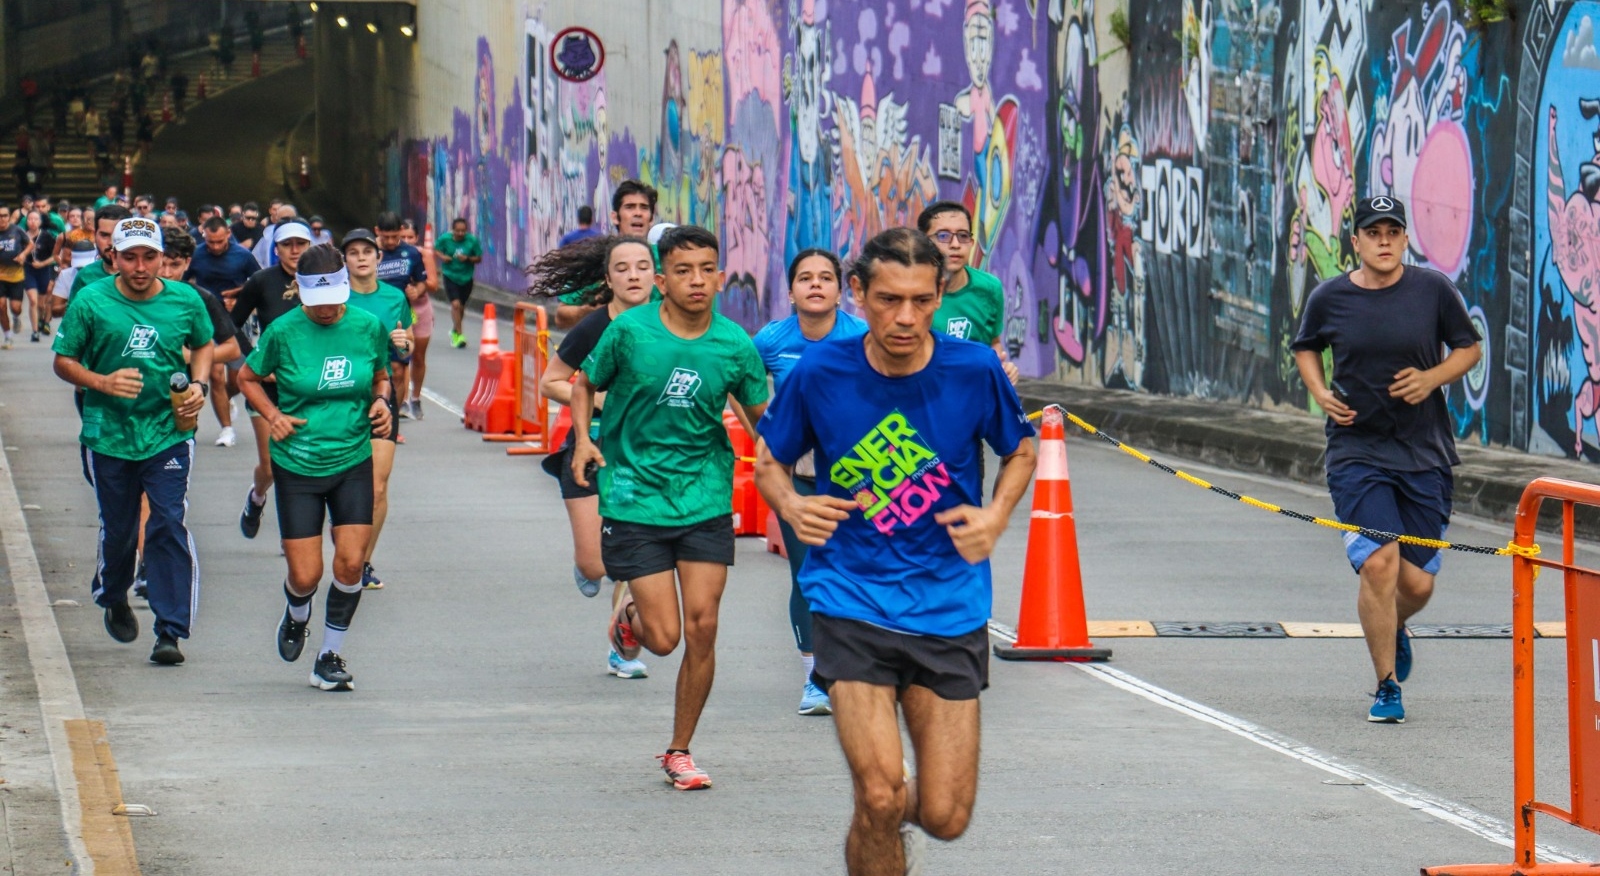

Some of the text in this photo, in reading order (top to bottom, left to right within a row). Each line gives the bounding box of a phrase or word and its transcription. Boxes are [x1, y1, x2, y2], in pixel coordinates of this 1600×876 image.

[124, 229, 153, 239] MOSCHINO
[950, 320, 968, 331] MM
[133, 327, 154, 338] MM
[129, 337, 150, 348] CB
[326, 359, 346, 370] MM
[324, 369, 345, 380] CB
[672, 371, 698, 386] MM
[666, 382, 690, 396] CB
